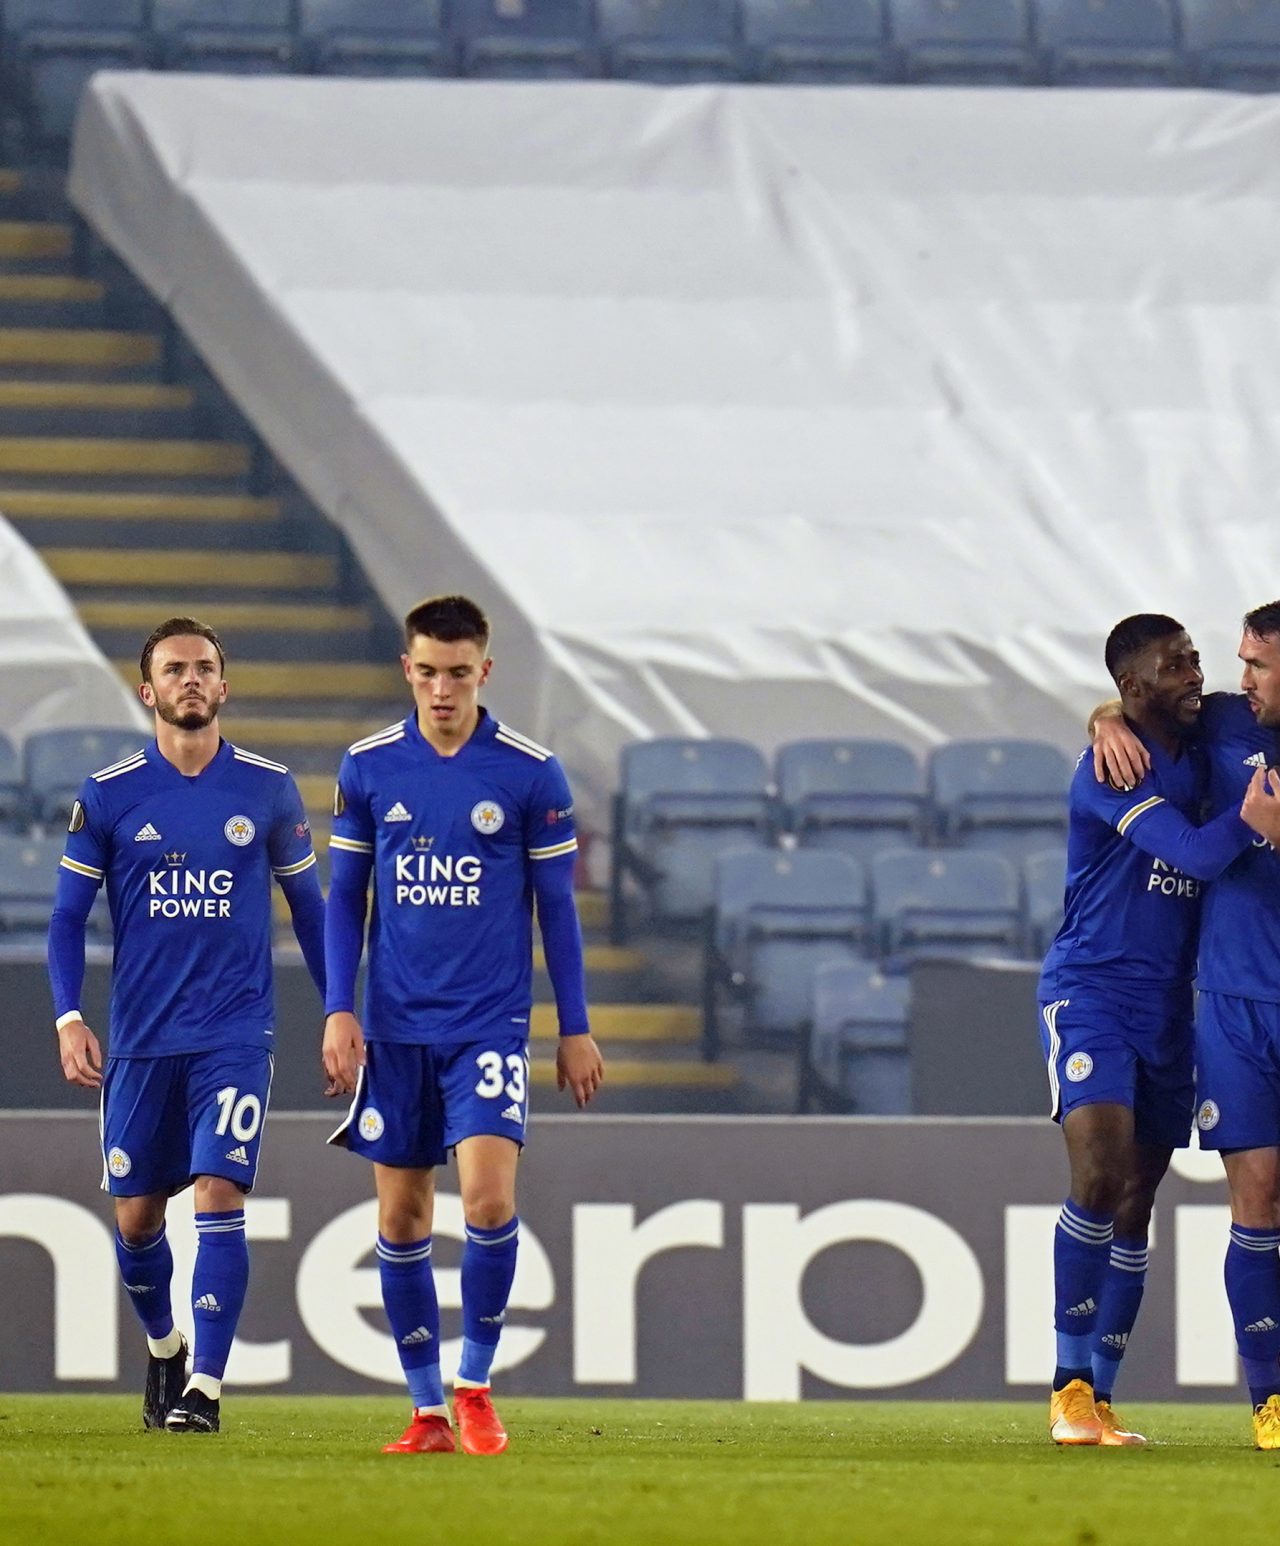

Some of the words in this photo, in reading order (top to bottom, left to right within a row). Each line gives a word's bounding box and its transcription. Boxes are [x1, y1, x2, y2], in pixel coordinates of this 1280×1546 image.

[149, 869, 234, 895] KING
[395, 854, 482, 883] KING
[150, 899, 231, 918] POWER
[396, 885, 481, 906] POWER
[475, 1050, 526, 1104] 33
[214, 1086, 261, 1142] 10
